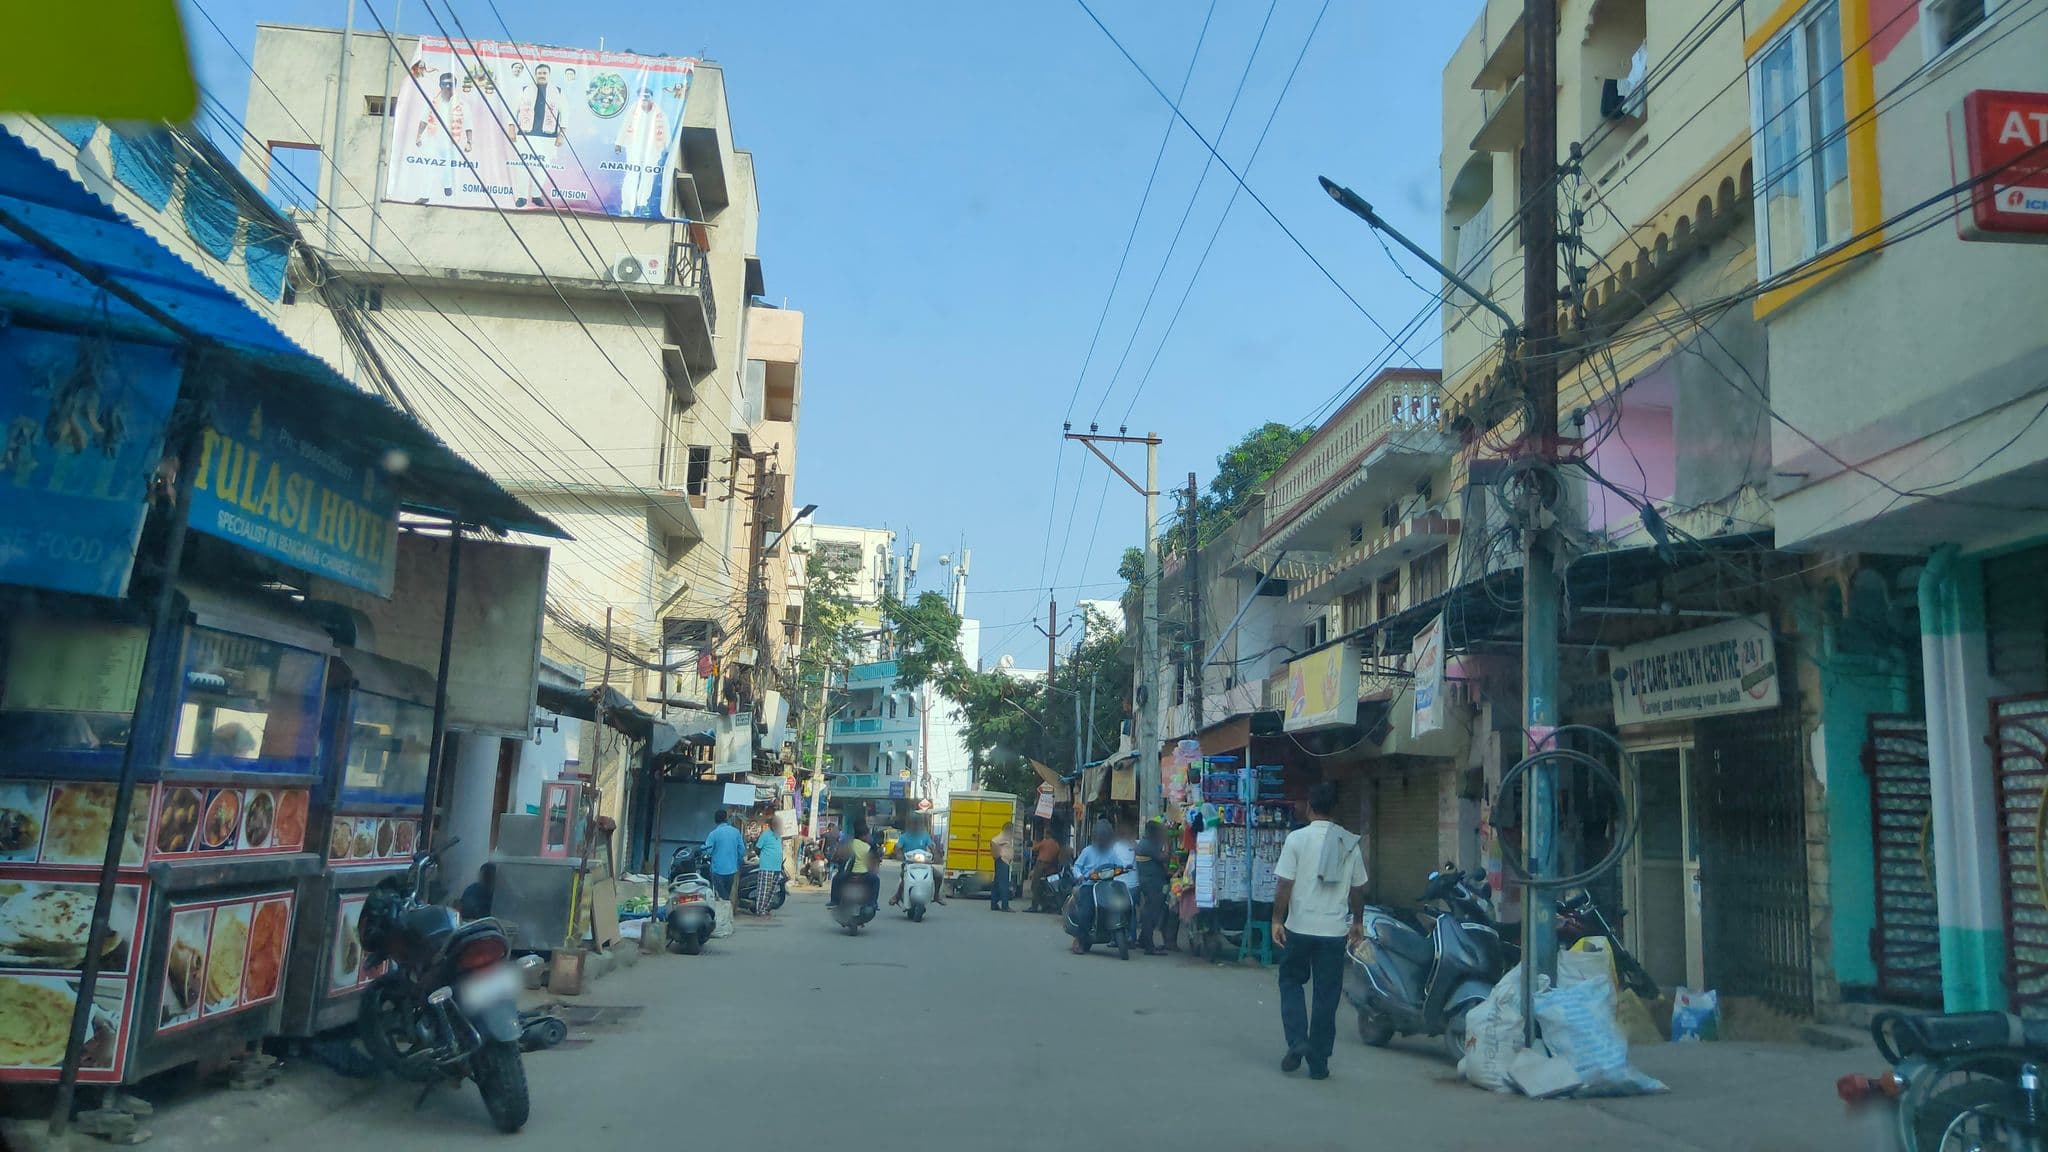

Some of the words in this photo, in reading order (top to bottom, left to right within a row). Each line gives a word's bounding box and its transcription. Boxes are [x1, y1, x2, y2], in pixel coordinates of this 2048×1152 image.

[406, 156, 447, 167] GAYAZ
[450, 160, 479, 169] BHAI
[600, 162, 641, 172] ANAND
[644, 166, 664, 174] GO
[194, 425, 315, 534] TULASI
[217, 509, 268, 545] SPECIALIST
[1646, 653, 1670, 693] CARE
[1668, 647, 1704, 690] HEALTH
[1702, 639, 1742, 684] CENTRE
